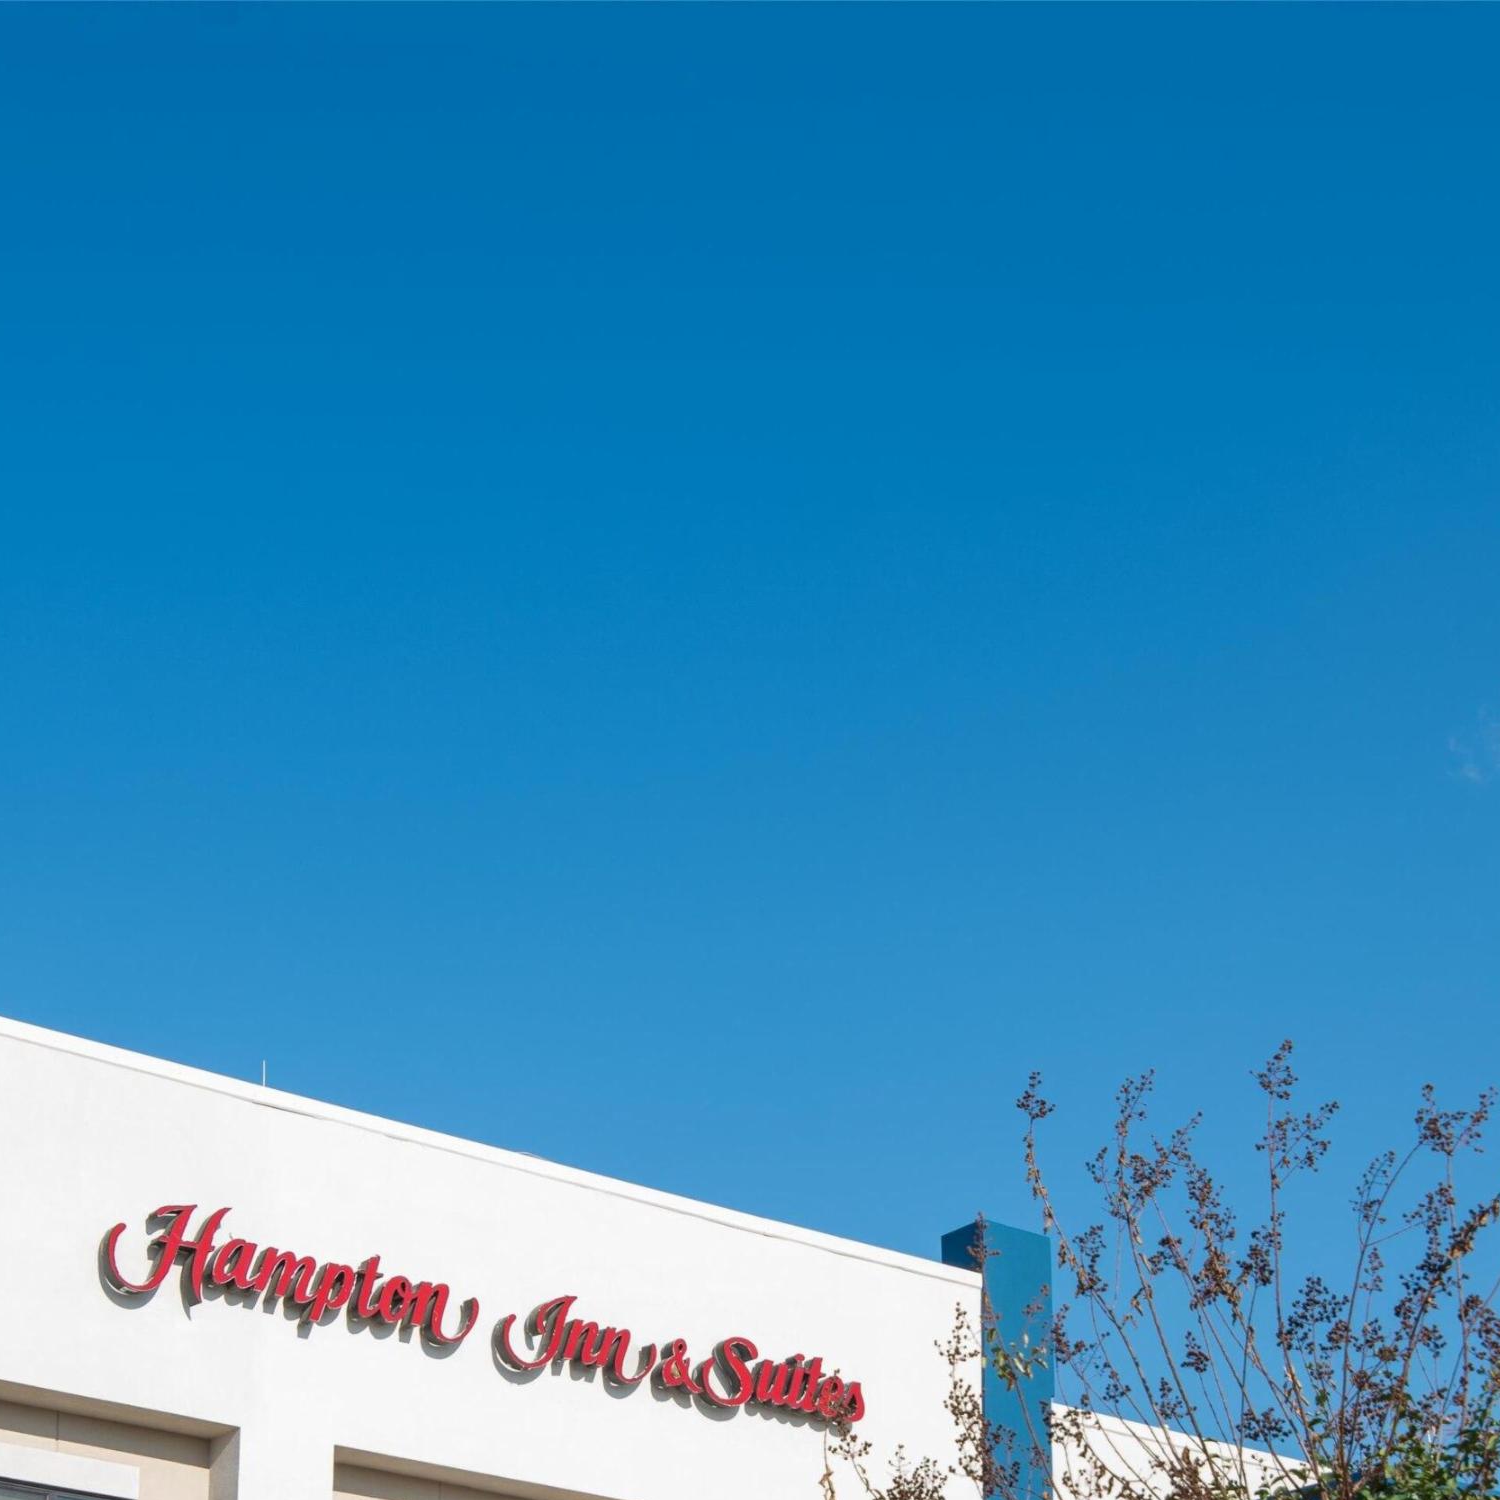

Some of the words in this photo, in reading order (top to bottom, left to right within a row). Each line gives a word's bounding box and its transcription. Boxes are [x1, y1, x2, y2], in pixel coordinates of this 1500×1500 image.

[102, 1204, 478, 1346] Hampton
[495, 1295, 657, 1386] Inn
[658, 1338, 701, 1394] &
[696, 1336, 866, 1425] Suites
